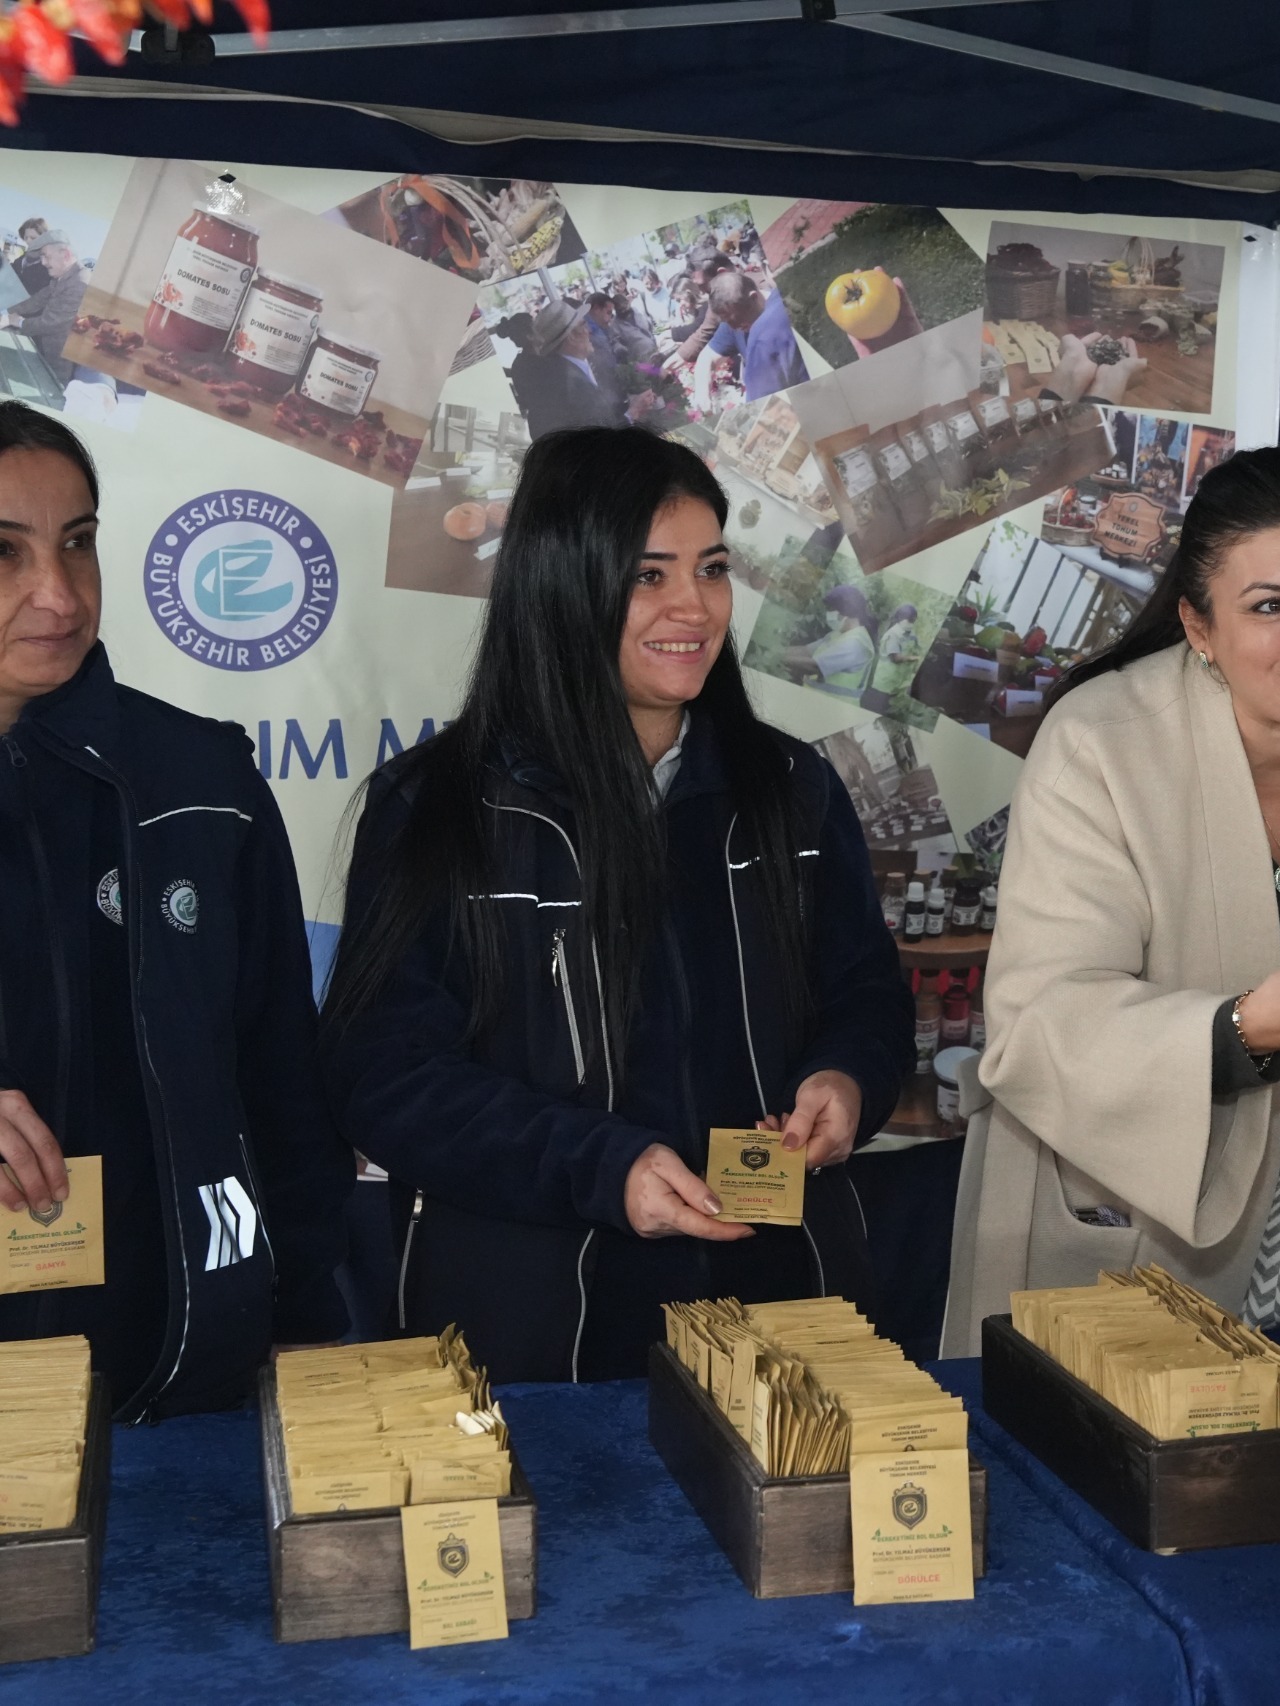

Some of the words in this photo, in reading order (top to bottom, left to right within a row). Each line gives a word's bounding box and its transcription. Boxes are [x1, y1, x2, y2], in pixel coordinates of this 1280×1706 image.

[177, 268, 210, 289] DOMATES
[211, 282, 231, 296] SOSU
[250, 318, 283, 337] DOMATES
[284, 331, 302, 344] SOSU
[176, 494, 300, 535] ESKİŞEHİR
[1112, 522, 1138, 535] TOHUM
[150, 552, 250, 666] BÜYÜKŞEHİR
[259, 554, 331, 663] BELEDİYESİ
[897, 1574, 941, 1584] BÖRÜLCE
